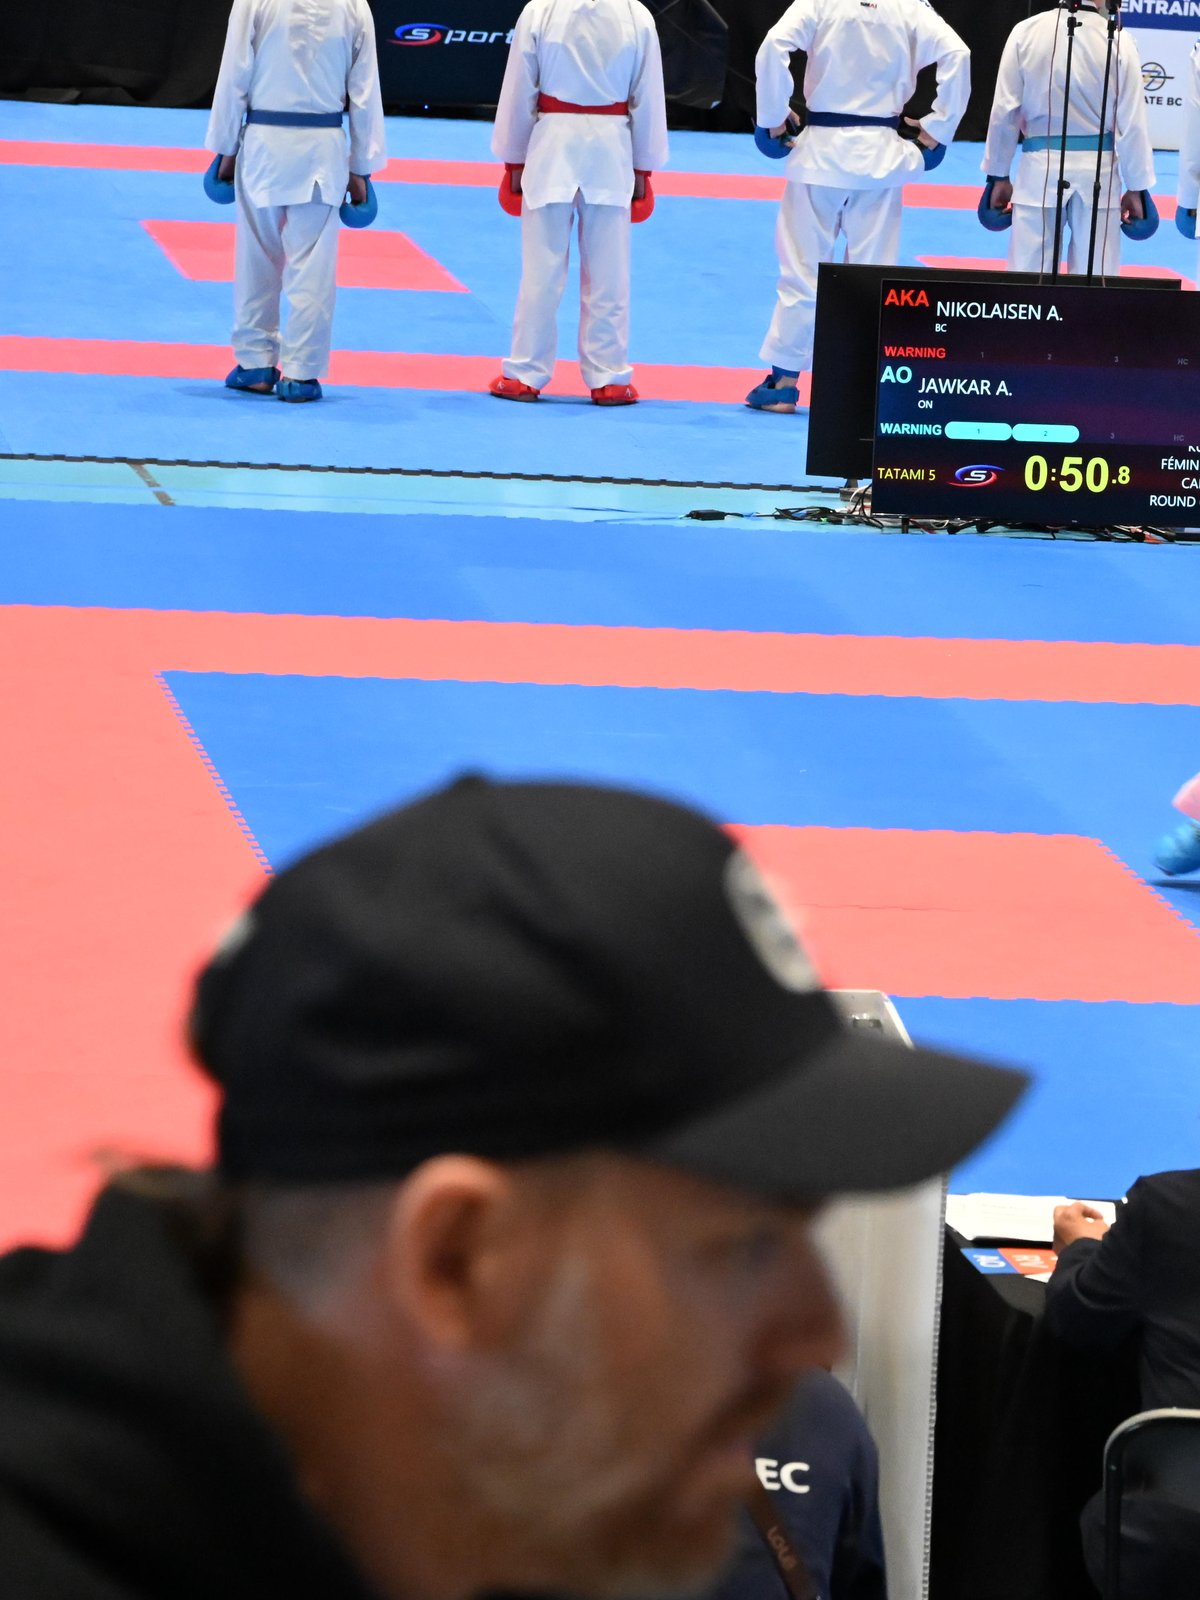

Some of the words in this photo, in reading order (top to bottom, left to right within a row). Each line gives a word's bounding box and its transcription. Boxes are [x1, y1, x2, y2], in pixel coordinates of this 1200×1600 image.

[1166, 97, 1183, 107] BC
[884, 289, 930, 307] AKA
[936, 301, 1042, 320] NIKOLAISEN
[1046, 305, 1063, 321] A.
[935, 323, 948, 333] BC
[884, 346, 947, 359] WARNING
[880, 365, 913, 384] AO
[917, 378, 992, 396] JAWKAR
[995, 380, 1013, 397] A.
[917, 399, 934, 409] ON
[880, 422, 943, 436] WARNING
[877, 468, 925, 481] TATAMI
[928, 469, 936, 481] 5
[1150, 495, 1196, 508] ROUND
